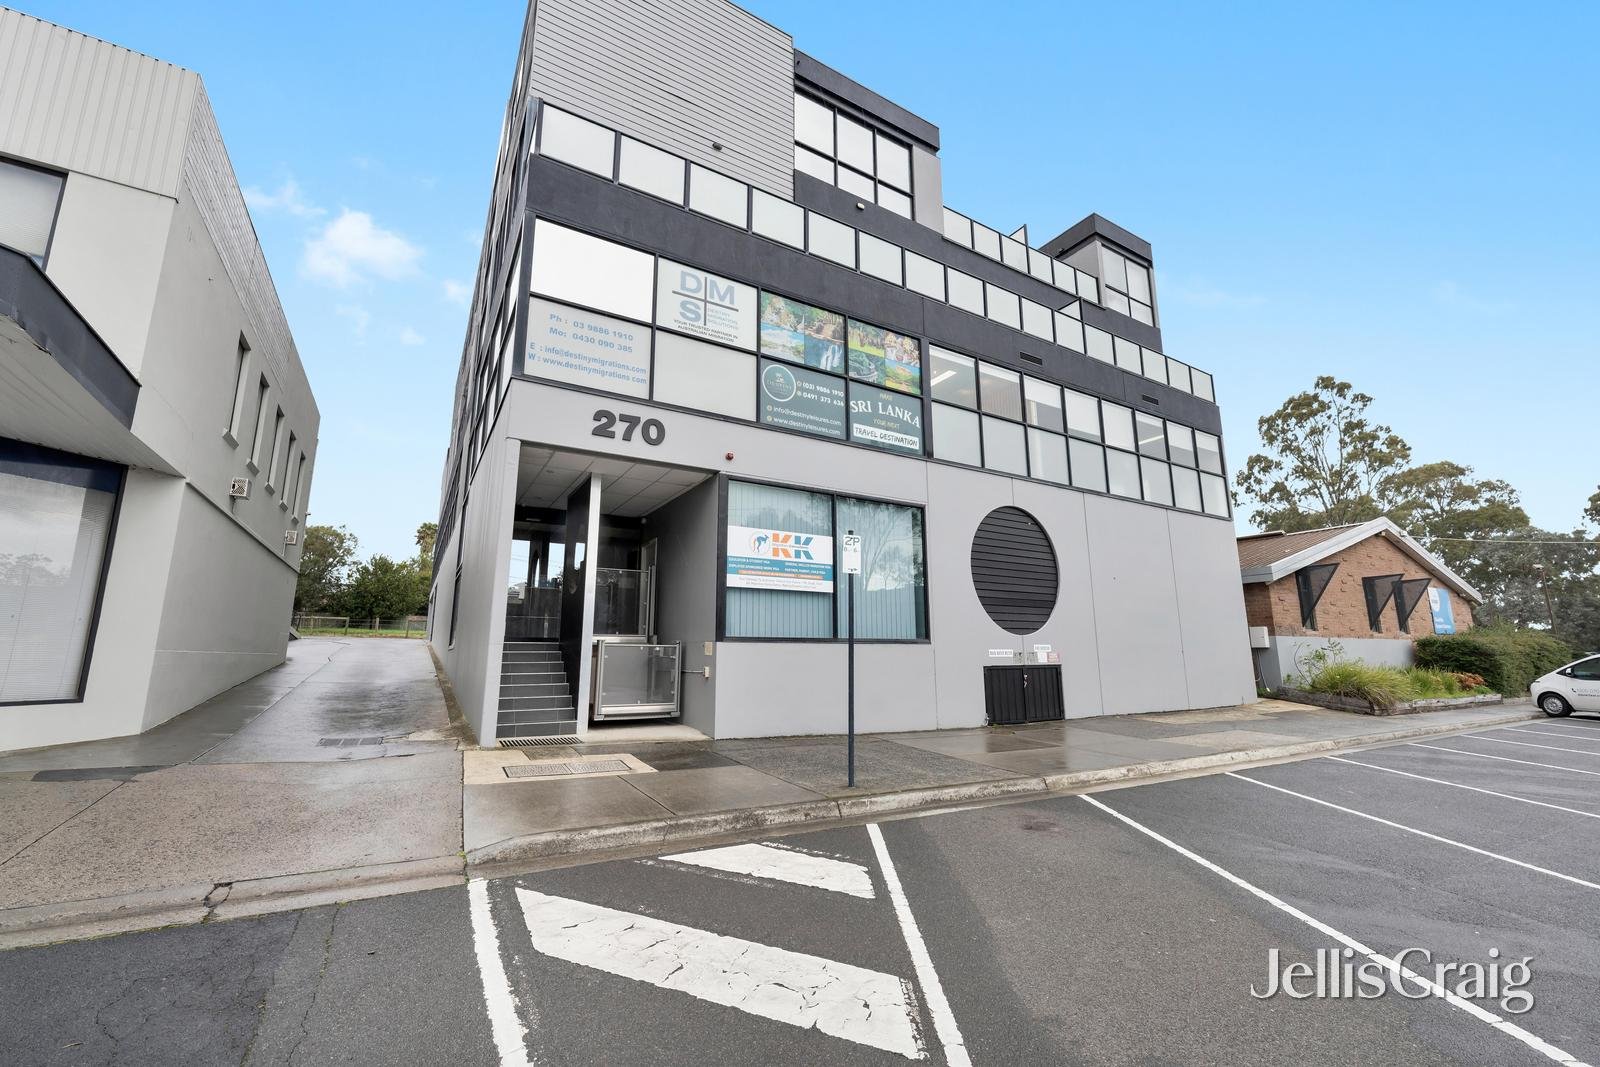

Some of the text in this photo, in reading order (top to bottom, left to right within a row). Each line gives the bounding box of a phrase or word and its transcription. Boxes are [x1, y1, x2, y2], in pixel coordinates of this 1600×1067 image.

[573, 320, 585, 330] 03
[612, 330, 634, 341] 1910
[677, 325, 735, 342] AUSTRALIAN MIGRATION
[688, 322, 711, 332] TRUSTED
[572, 333, 596, 344] 0430
[598, 339, 615, 349] 090
[617, 344, 633, 353] 385
[528, 352, 536, 361] W
[849, 400, 921, 429] SRI LANKA
[591, 409, 666, 446] 270
[855, 427, 918, 447] TRAVEL DESTINATION
[772, 532, 815, 560] KK
[844, 536, 860, 546] 2P
